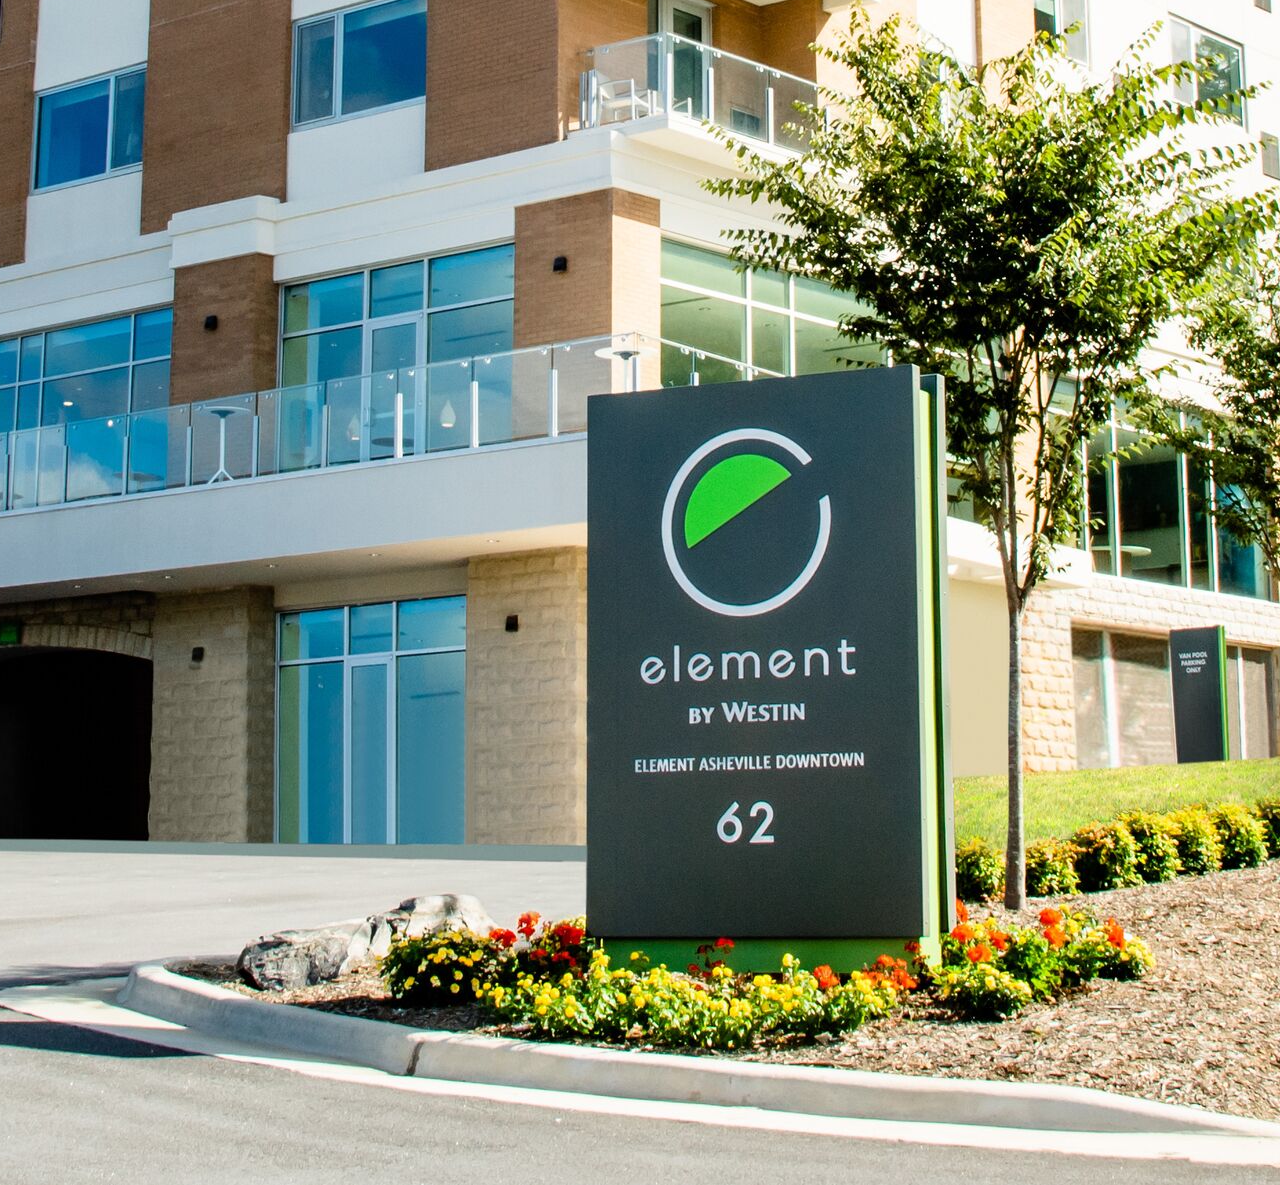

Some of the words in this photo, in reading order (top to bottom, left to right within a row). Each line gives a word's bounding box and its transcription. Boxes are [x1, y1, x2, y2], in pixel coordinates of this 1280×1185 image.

[640, 639, 856, 685] element
[688, 707, 715, 724] BY
[635, 757, 696, 773] ELEMENT
[699, 755, 772, 772] ASHEVILLE
[776, 752, 865, 769] DOWNTOWN
[716, 801, 775, 844] 62
